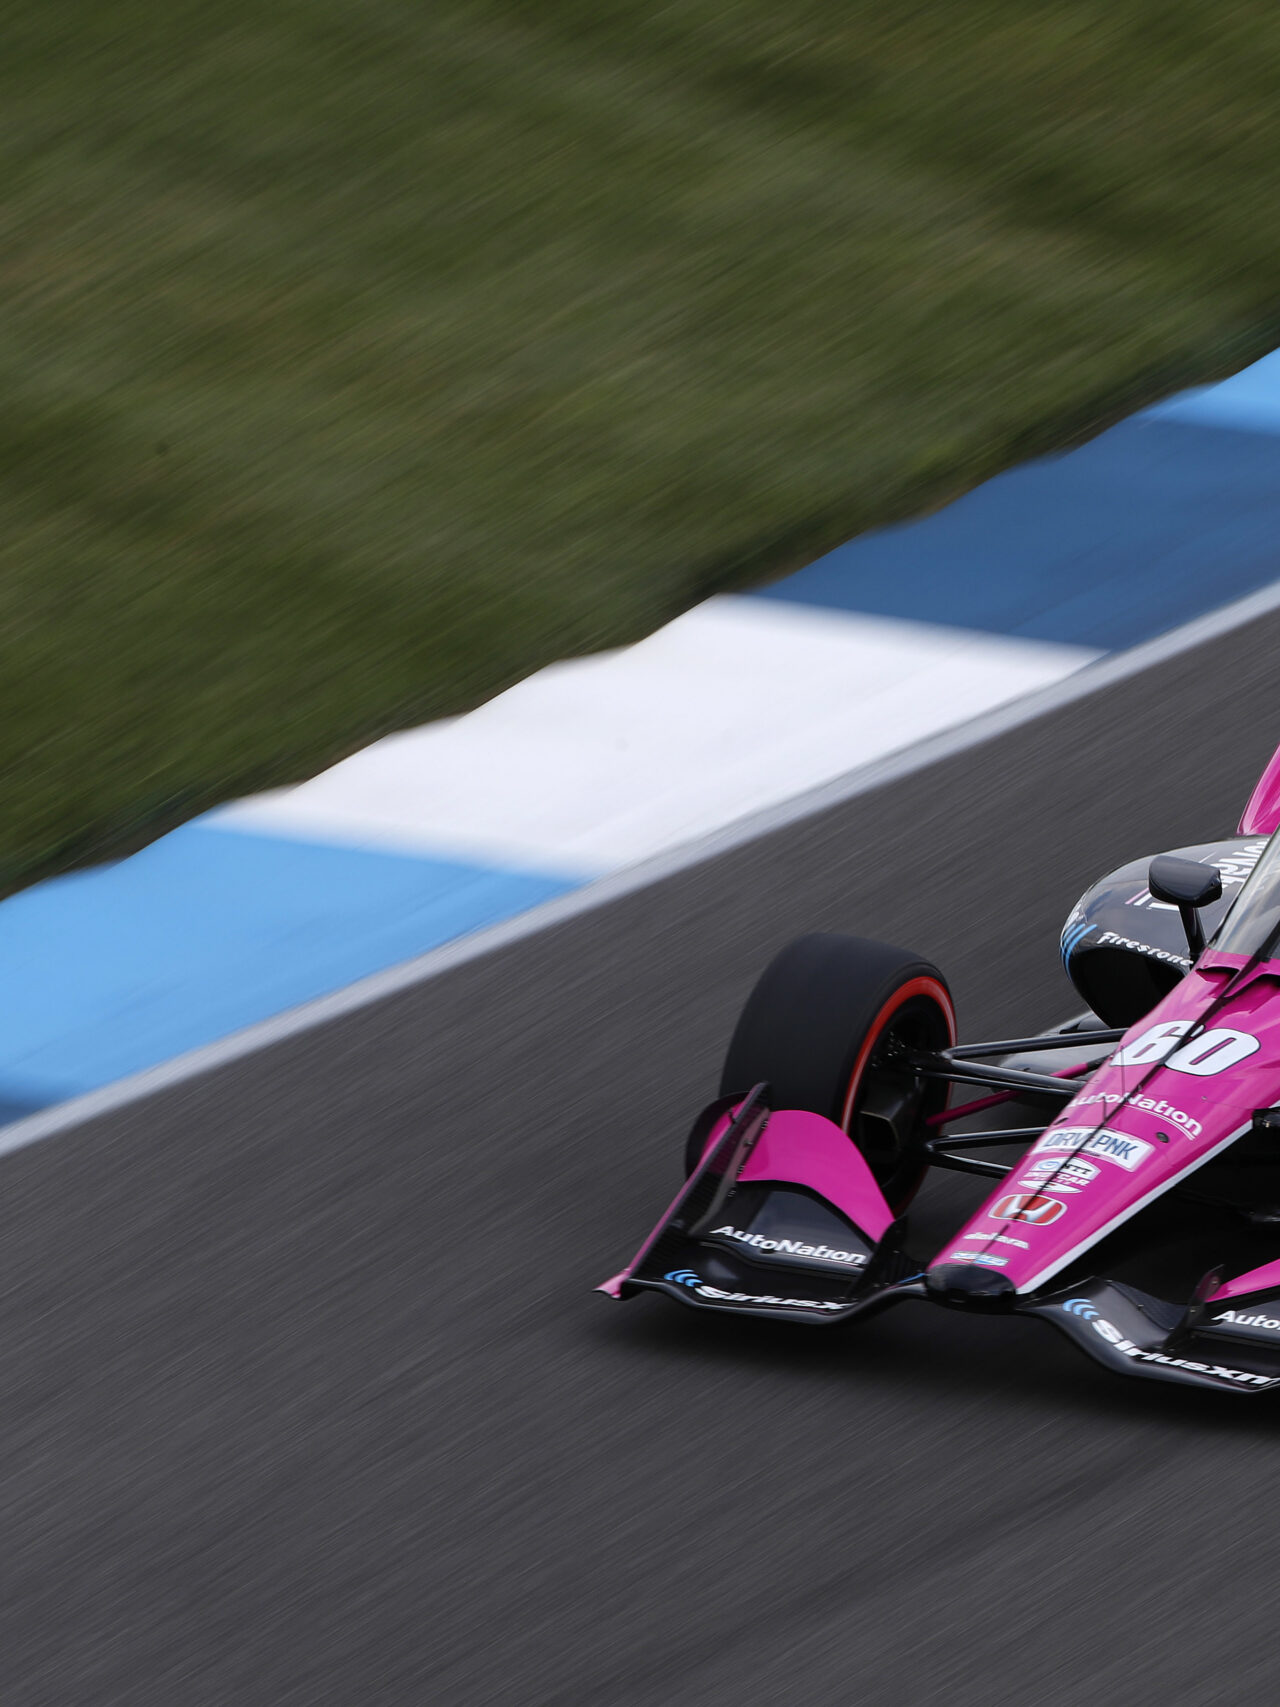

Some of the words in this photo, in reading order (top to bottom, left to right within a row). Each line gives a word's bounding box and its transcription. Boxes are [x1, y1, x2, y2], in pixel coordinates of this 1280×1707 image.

[1097, 931, 1194, 966] Firestone
[1110, 1020, 1260, 1076] 60
[1091, 1136, 1138, 1160] PNK
[709, 1226, 867, 1264] AutoNation
